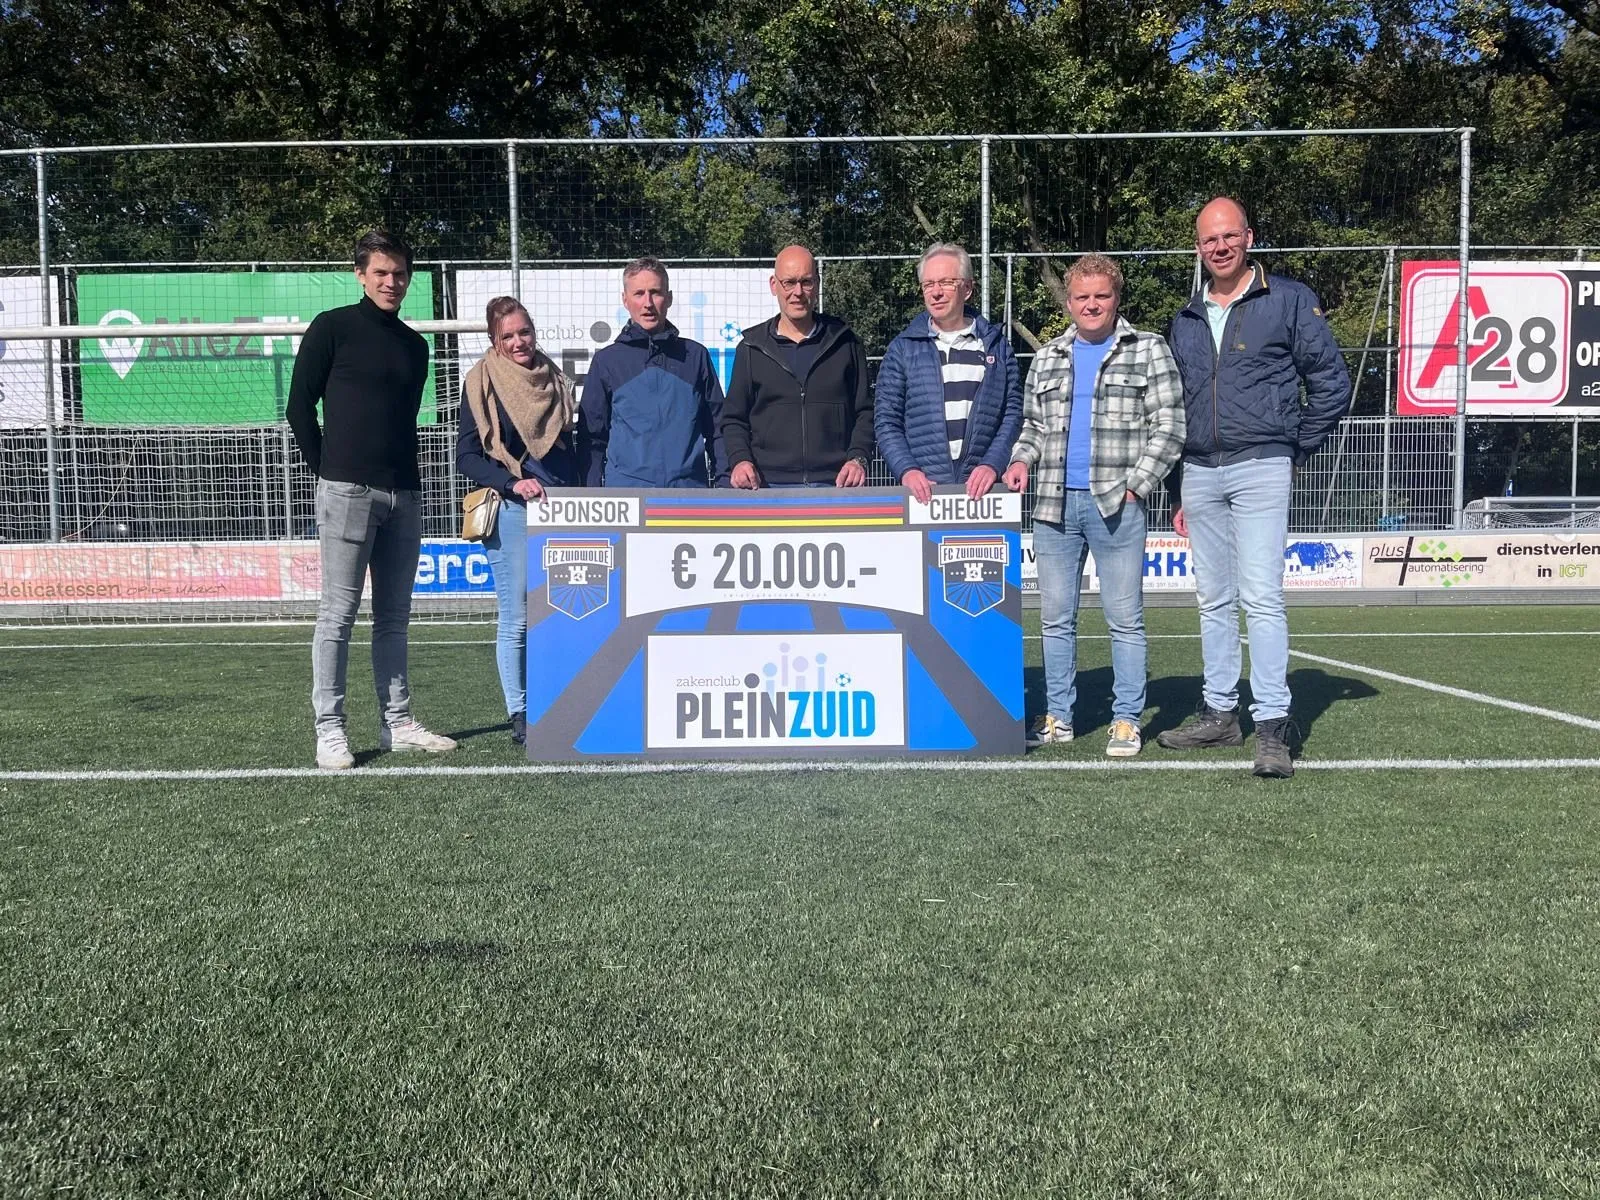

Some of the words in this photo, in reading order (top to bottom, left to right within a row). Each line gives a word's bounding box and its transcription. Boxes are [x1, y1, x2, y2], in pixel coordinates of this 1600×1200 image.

[1415, 286, 1557, 388] A28
[538, 501, 630, 523] SPONSOR
[930, 498, 1003, 520] CHEQUE
[943, 547, 954, 561] FC
[956, 546, 1005, 560] ZUIDWOLDE
[1369, 543, 1405, 560] plus
[1496, 542, 1600, 556] dienstverlen
[547, 551, 558, 564] FC
[560, 550, 609, 564] ZUIDWOLDE
[671, 543, 697, 589] €
[713, 542, 877, 590] 20.000.-
[1408, 562, 1484, 574] automatisering
[1537, 565, 1552, 578] in
[1559, 564, 1588, 578] ICT
[0, 582, 121, 597] delicatessen
[676, 675, 741, 687] zakenclub
